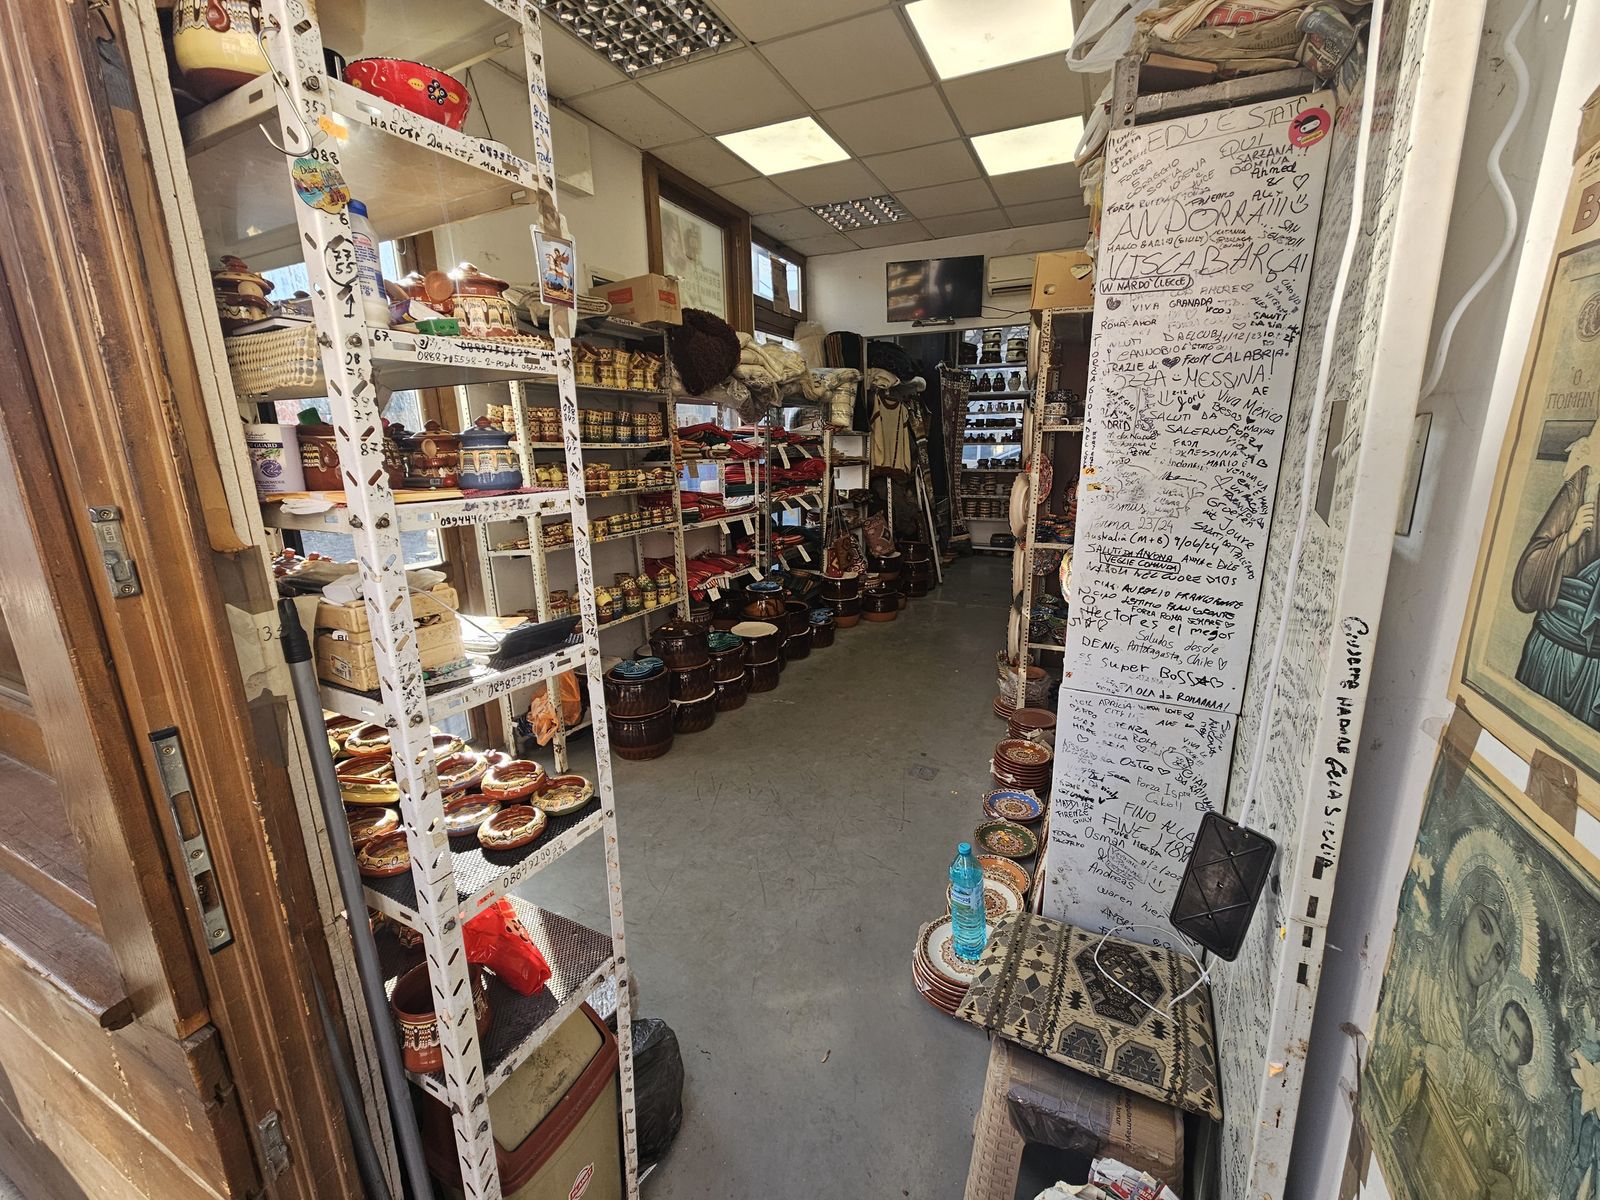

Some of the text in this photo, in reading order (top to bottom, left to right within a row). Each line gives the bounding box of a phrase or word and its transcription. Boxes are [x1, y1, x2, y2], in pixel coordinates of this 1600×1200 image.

[1250, 161, 1297, 179] Ahmed
[1131, 302, 1161, 313] VIVA
[1168, 296, 1214, 308] GRANADA
[1206, 497, 1254, 528] Groeten
[1186, 655, 1214, 669] Chile
[1084, 826, 1126, 849] Osman
[1088, 861, 1137, 891] Andreas
[1096, 885, 1133, 907] waren
[1140, 901, 1166, 919] hier
